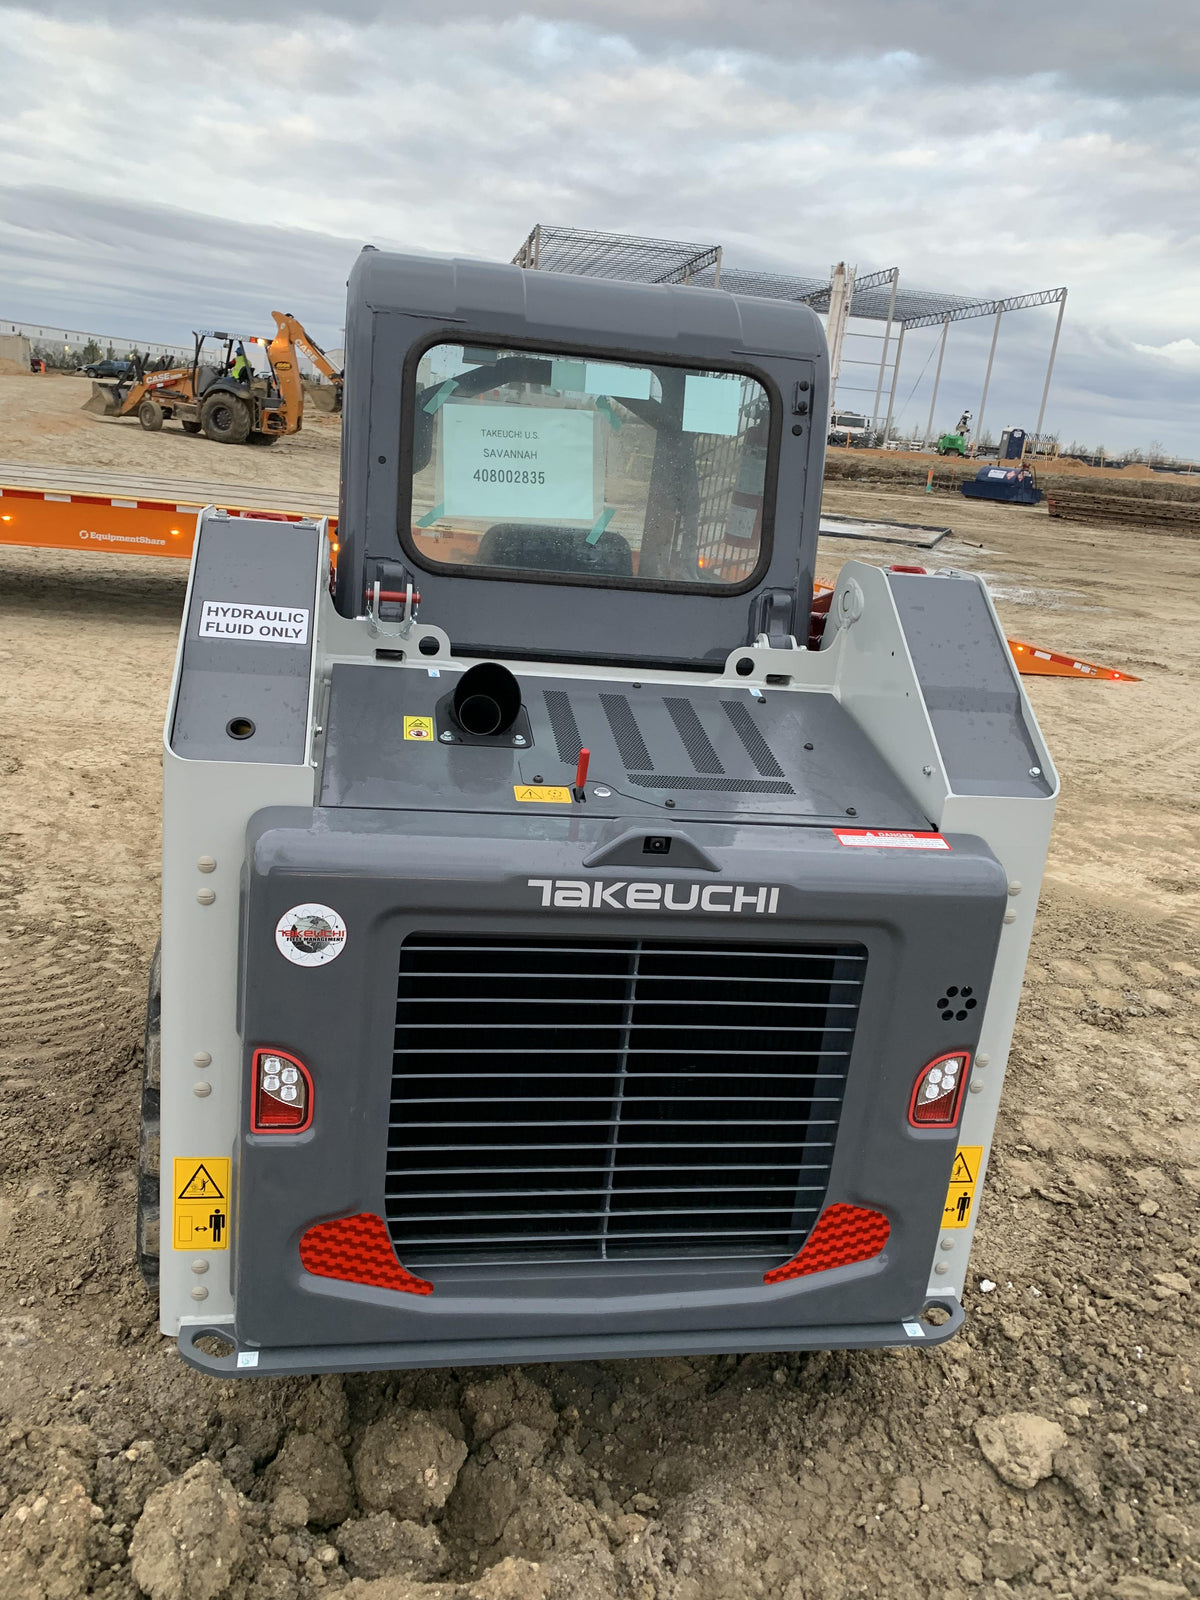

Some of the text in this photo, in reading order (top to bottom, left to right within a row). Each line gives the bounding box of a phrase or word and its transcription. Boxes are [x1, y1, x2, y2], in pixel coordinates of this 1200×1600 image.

[294, 338, 318, 363] CASE
[145, 372, 171, 384] CASE
[481, 429, 540, 440] TAKEUCHI U.S.
[483, 448, 537, 459] SAVANNAH
[473, 469, 545, 484] 408002835
[90, 531, 166, 546] EquipmentShare
[207, 606, 305, 624] HYDRAULIC
[205, 621, 303, 639] FLUID ONLY
[527, 879, 780, 914] TAKEUCHI
